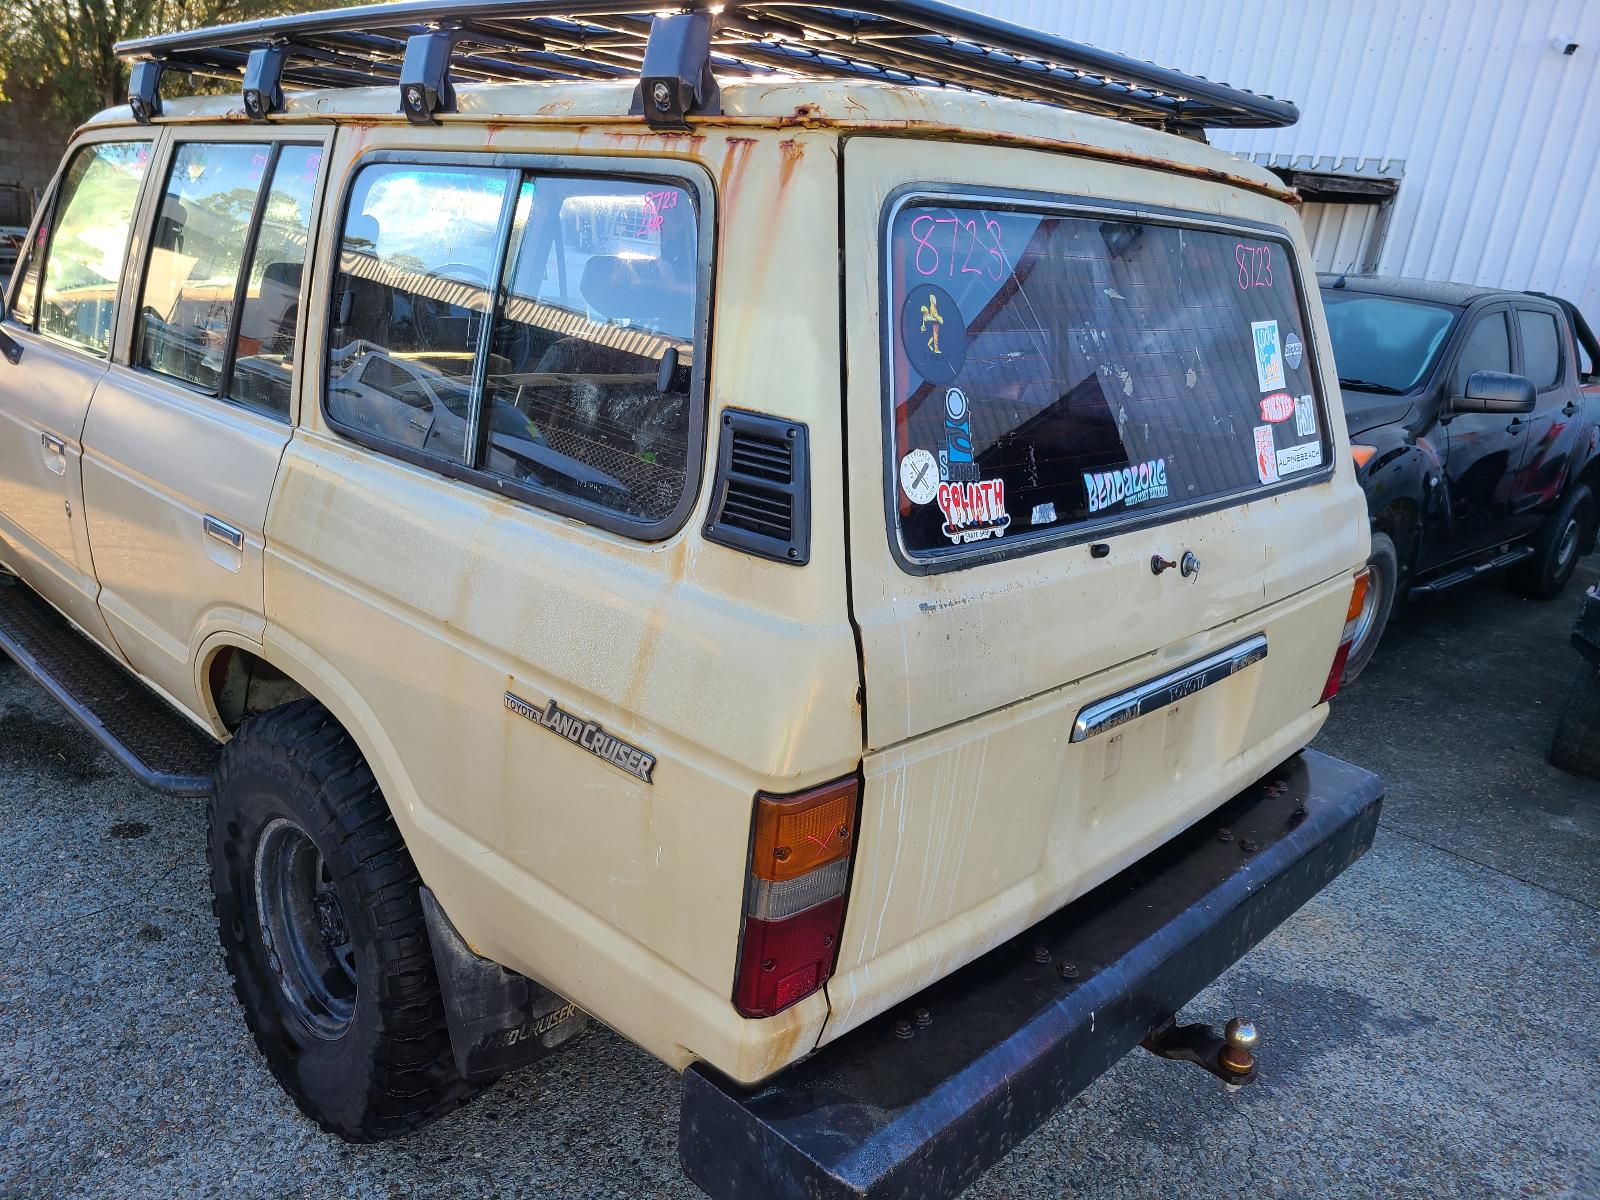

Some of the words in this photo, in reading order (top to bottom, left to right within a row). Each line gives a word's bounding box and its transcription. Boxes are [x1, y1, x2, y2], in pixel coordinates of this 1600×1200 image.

[643, 191, 679, 214] 8723
[911, 215, 1005, 281] 8723
[1235, 243, 1273, 290] 8723
[938, 479, 1004, 524] GOLIATH
[1083, 458, 1167, 513] BENDALONG
[505, 696, 538, 723] TOYOTA
[1169, 674, 1208, 702] TOYOTA
